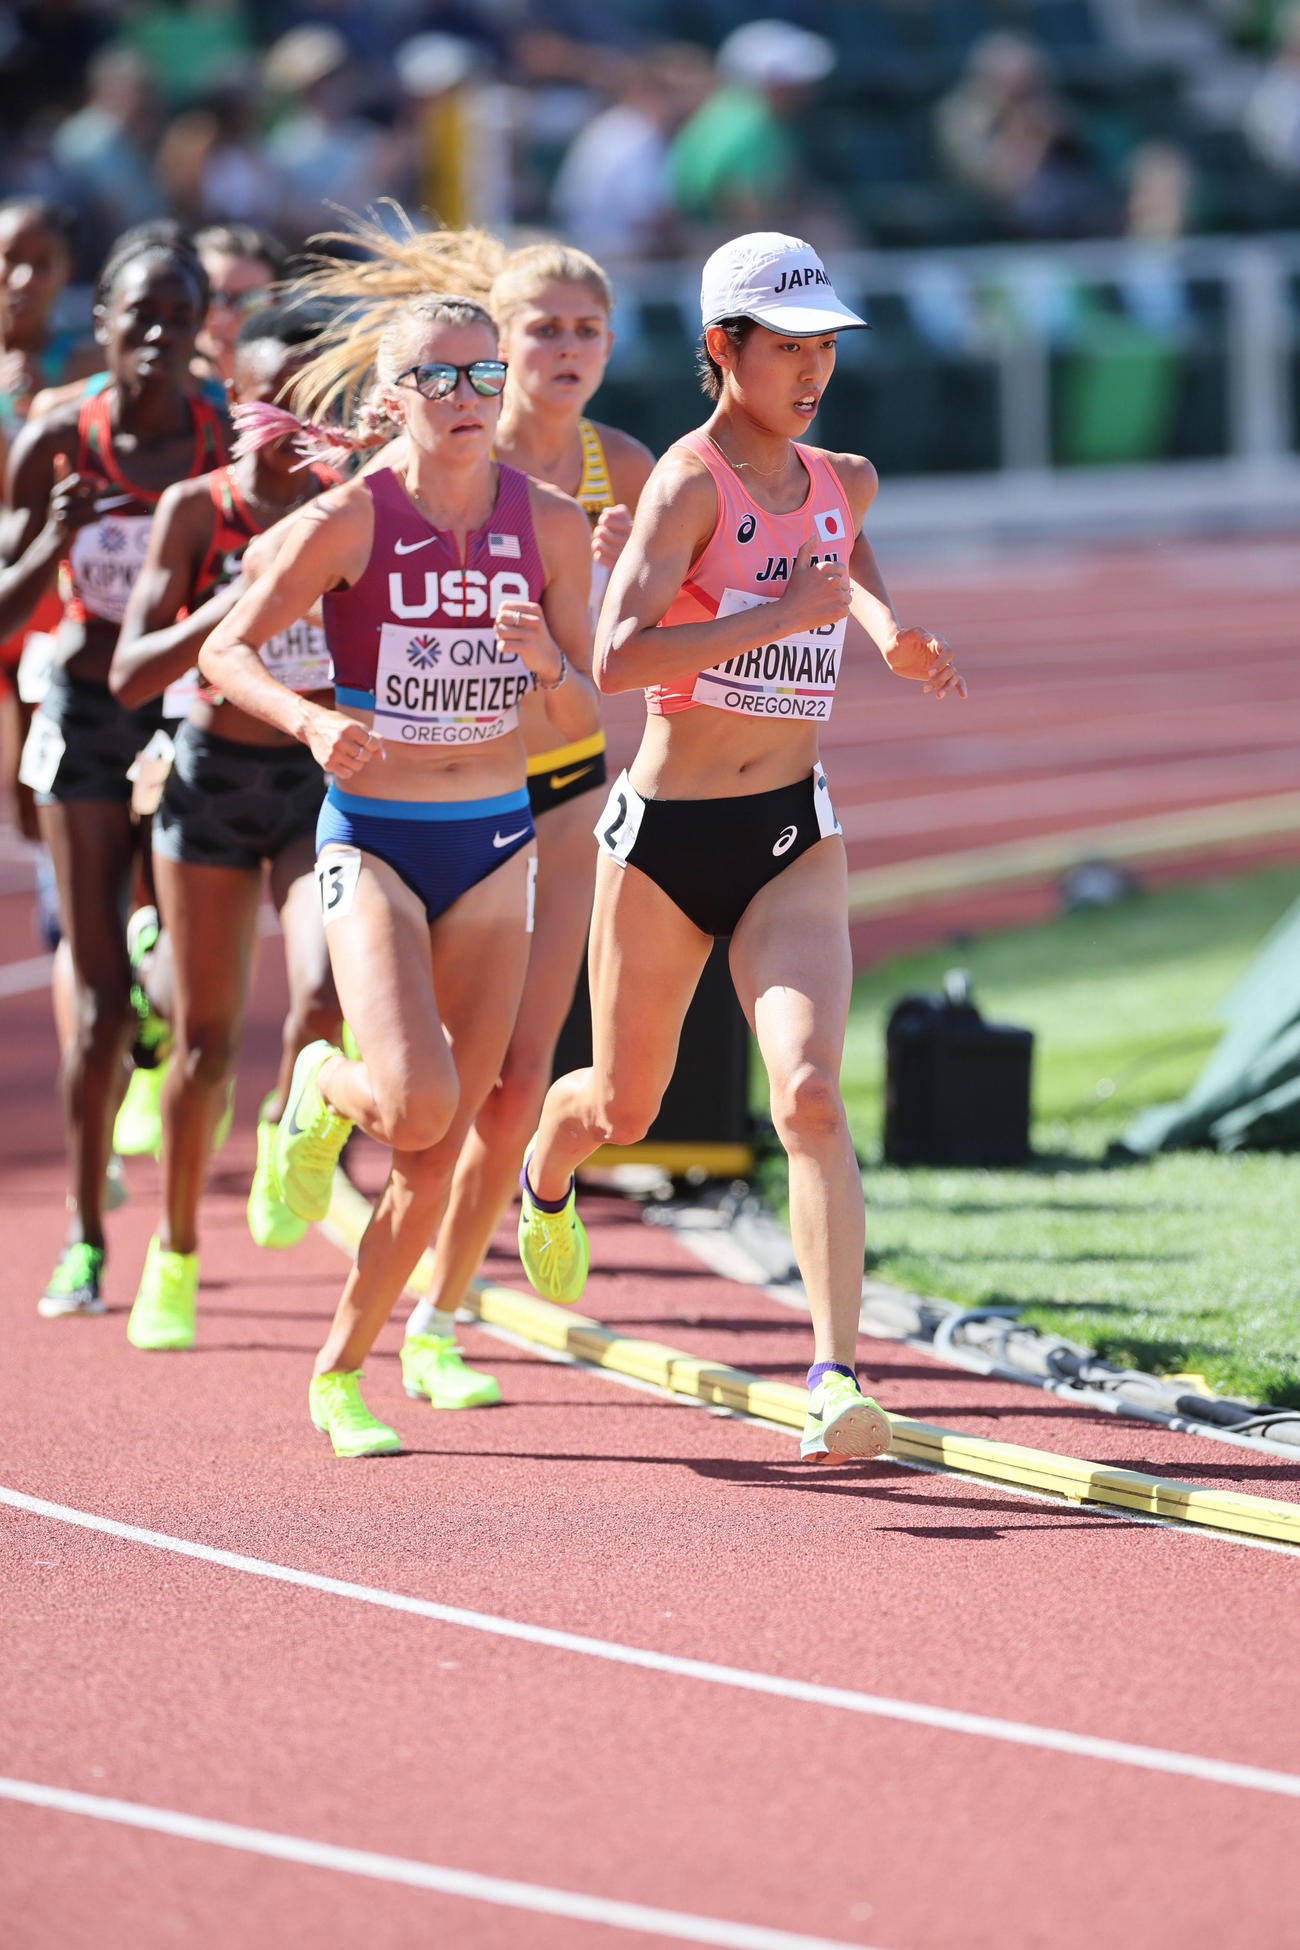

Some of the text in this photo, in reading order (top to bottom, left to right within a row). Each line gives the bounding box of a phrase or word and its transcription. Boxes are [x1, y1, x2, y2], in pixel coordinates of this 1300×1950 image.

[388, 569, 530, 620] USA
[711, 643, 837, 684] IRONAKA
[385, 673, 529, 712] SCHWEIZER
[724, 691, 827, 718] OREGON22
[401, 720, 505, 743] OREGON22
[603, 791, 628, 851] 2
[318, 865, 345, 910] 13
